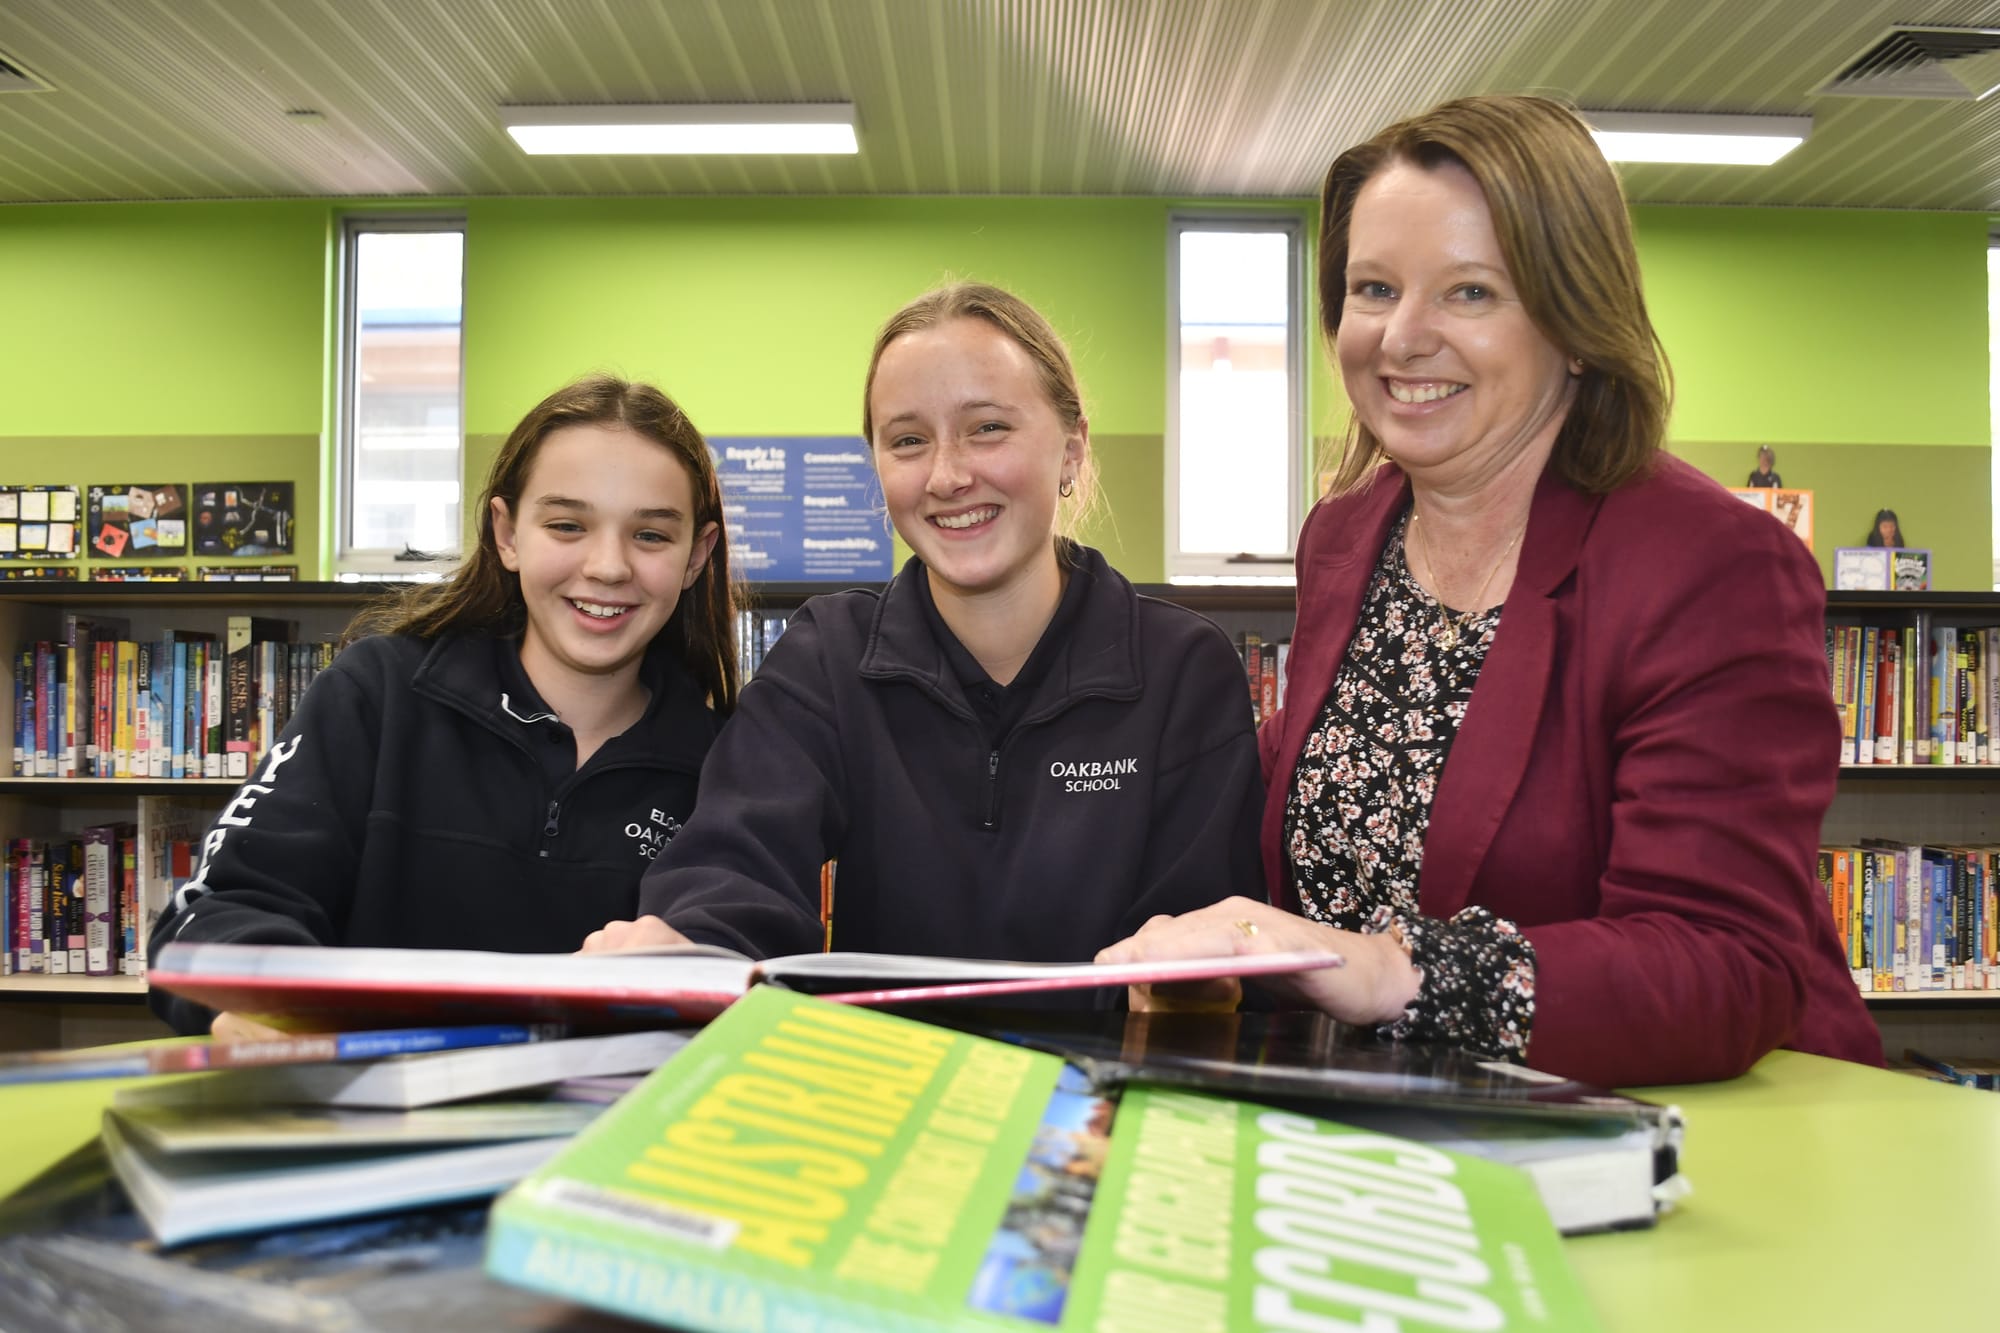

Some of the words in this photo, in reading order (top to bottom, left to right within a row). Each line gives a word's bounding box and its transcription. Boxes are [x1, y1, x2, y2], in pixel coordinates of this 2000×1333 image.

[1050, 758, 1138, 777] OAKBANK
[1065, 778, 1121, 792] SCHOOL
[628, 1005, 957, 1269] AUSTRALIA
[523, 1236, 767, 1333] AUSTRALIA
